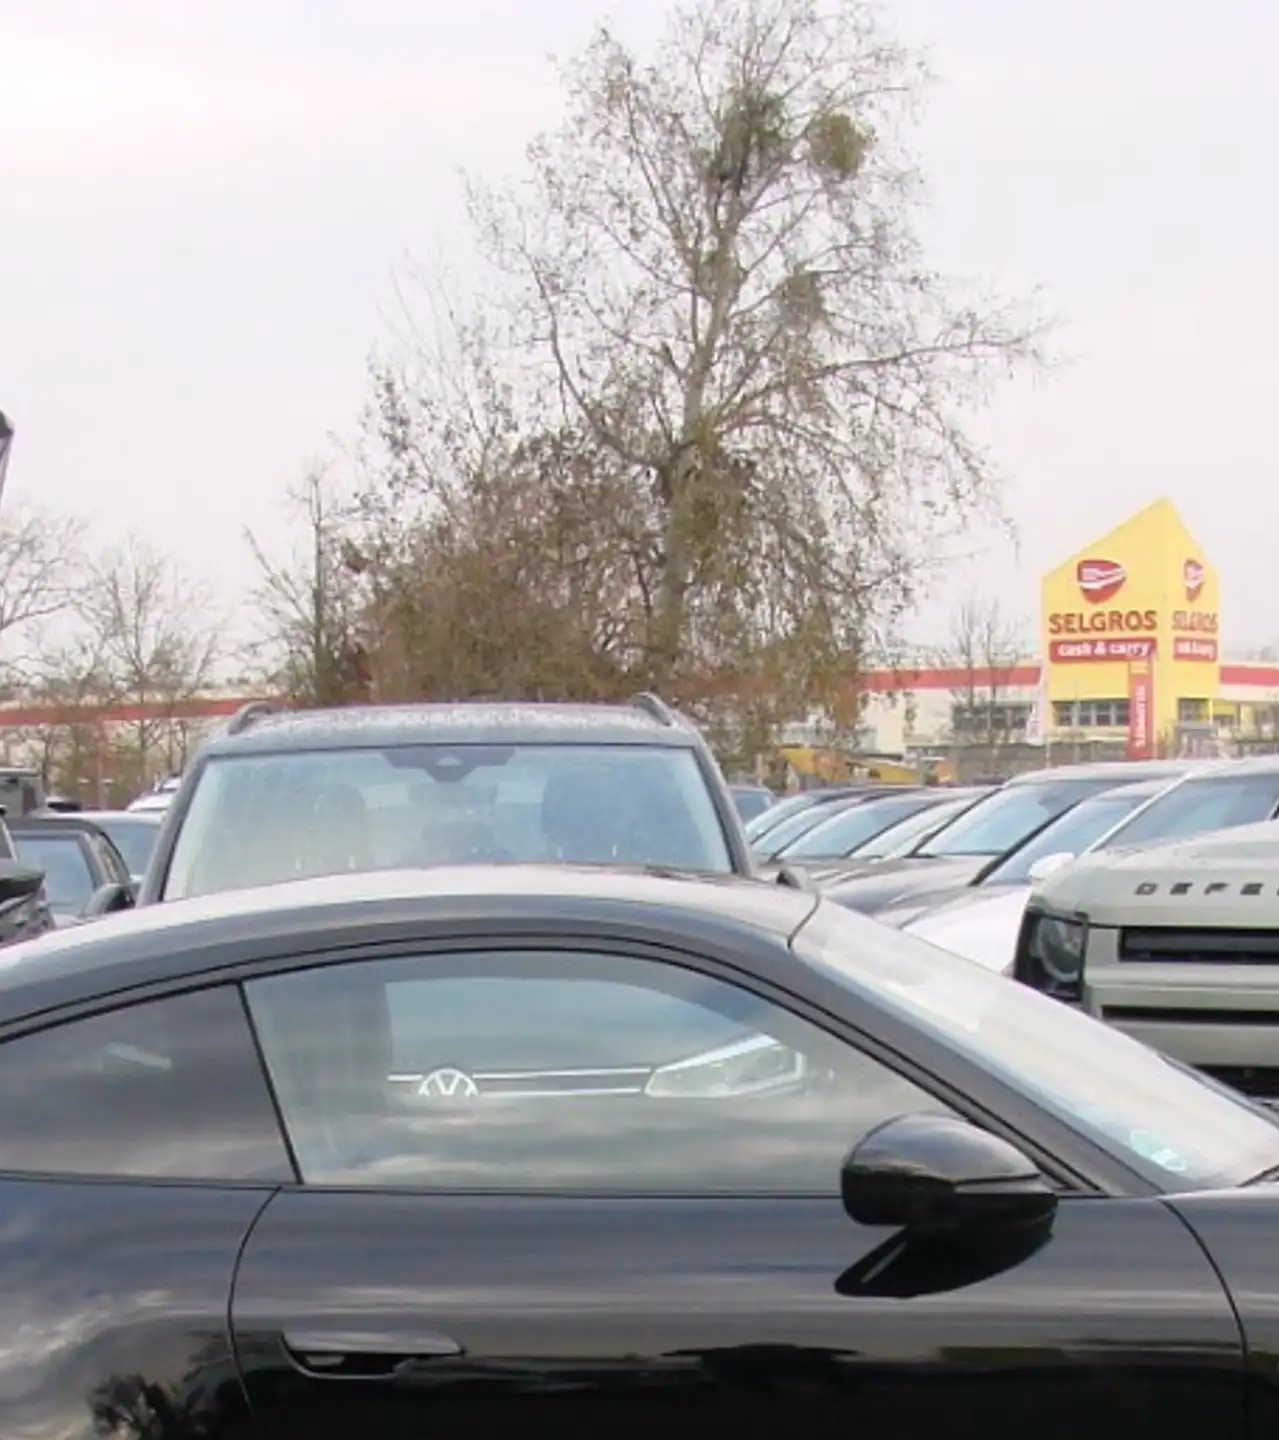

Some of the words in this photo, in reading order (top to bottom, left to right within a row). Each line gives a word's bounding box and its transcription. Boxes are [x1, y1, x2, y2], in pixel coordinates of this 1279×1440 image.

[1048, 609, 1158, 634] SELGROS
[1057, 641, 1092, 657] cash
[1094, 640, 1107, 656] &
[1109, 640, 1152, 658] carry
